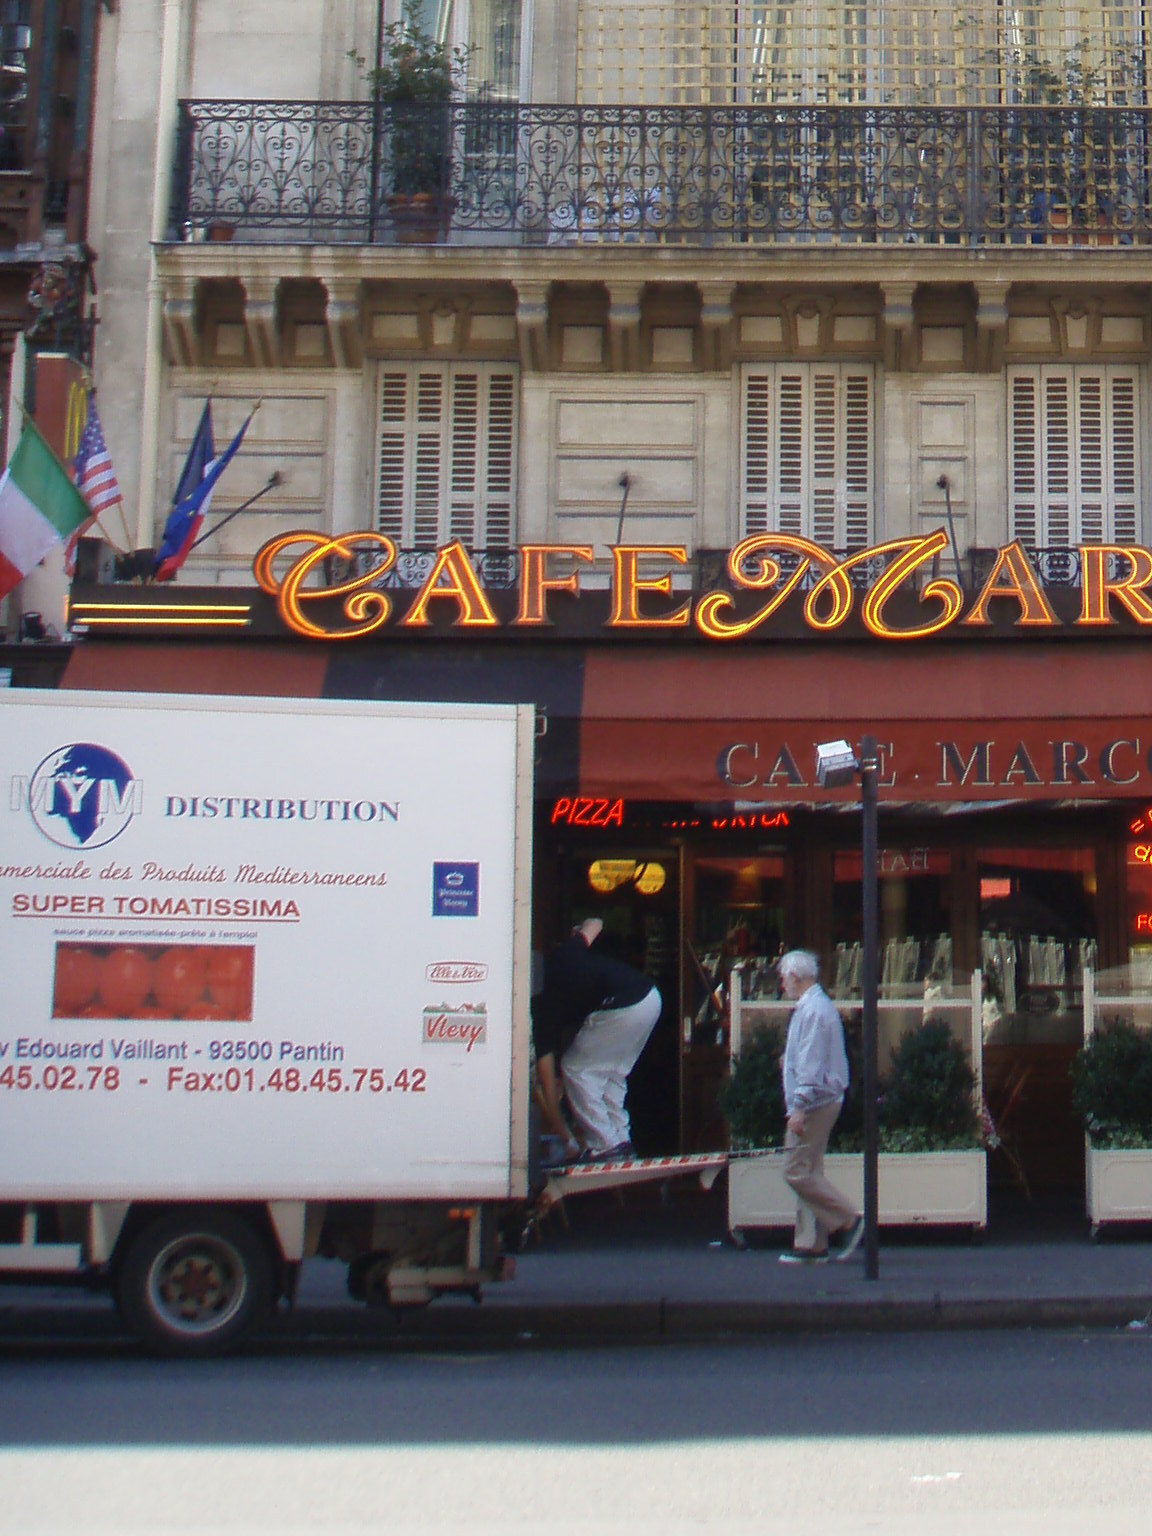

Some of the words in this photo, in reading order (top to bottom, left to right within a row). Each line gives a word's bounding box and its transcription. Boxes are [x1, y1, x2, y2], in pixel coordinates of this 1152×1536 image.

[253, 529, 693, 640] CAFE
[716, 742, 898, 788] CAE
[10, 775, 144, 815] MYM
[166, 795, 400, 822] DISTRIBUTION
[551, 797, 625, 828] PIZZA
[0, 861, 92, 881] merciale
[100, 863, 133, 881] des
[141, 862, 227, 883] Produits
[234, 864, 388, 887] Mediterraneens
[13, 894, 104, 913] SUPER
[114, 896, 300, 917] TOMATISSIMA
[426, 1014, 483, 1052] Vlevy
[16, 1038, 104, 1058] Edouard
[110, 1039, 189, 1059] Vaillant
[209, 1041, 273, 1061] 93500
[280, 1041, 345, 1061] Pantin
[168, 1066, 427, 1093] Fax:01.48.45.75.42
